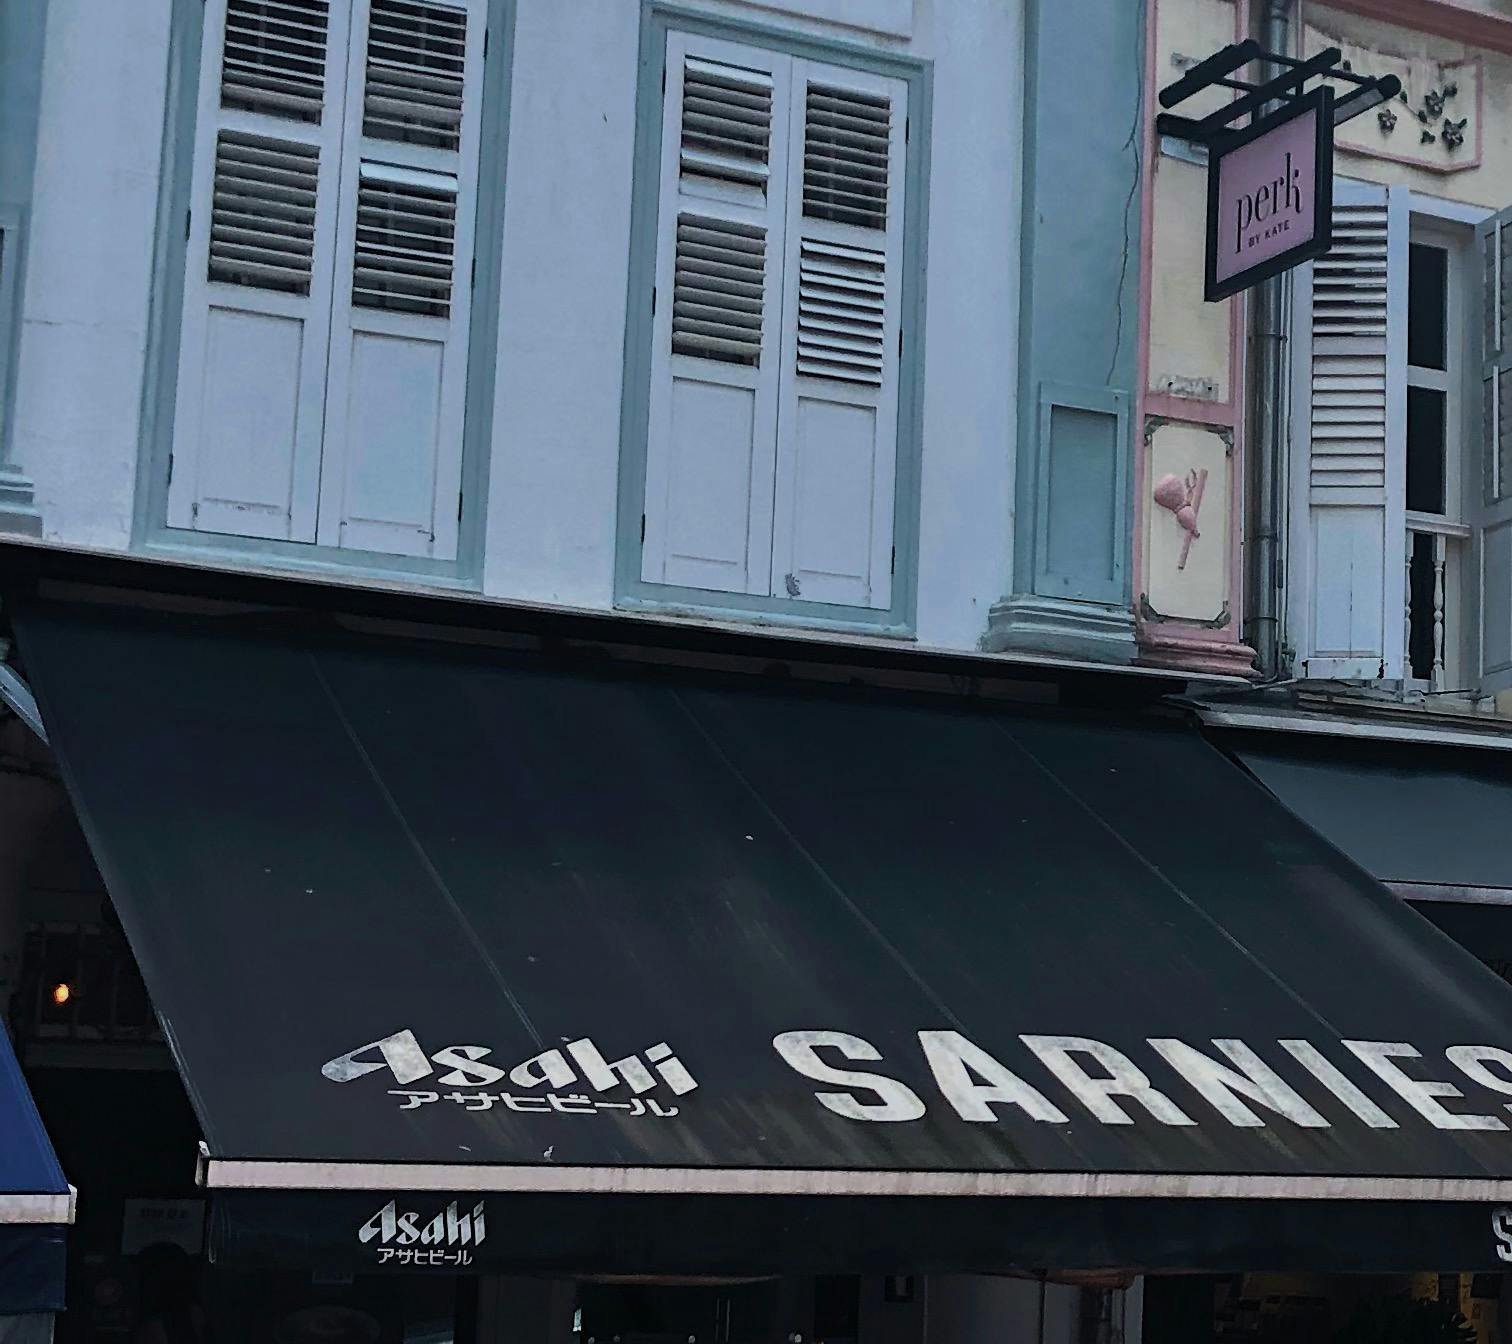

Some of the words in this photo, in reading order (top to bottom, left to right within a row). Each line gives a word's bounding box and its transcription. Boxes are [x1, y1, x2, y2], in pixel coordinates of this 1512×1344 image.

[1235, 152, 1304, 254] perk
[1248, 232, 1261, 247] BY
[1264, 219, 1290, 240] KATE
[321, 1028, 699, 1096] Asahi
[387, 1089, 680, 1117] アサヒビール
[358, 1199, 487, 1247] Asahi
[376, 1247, 473, 1266] アサヒビール
